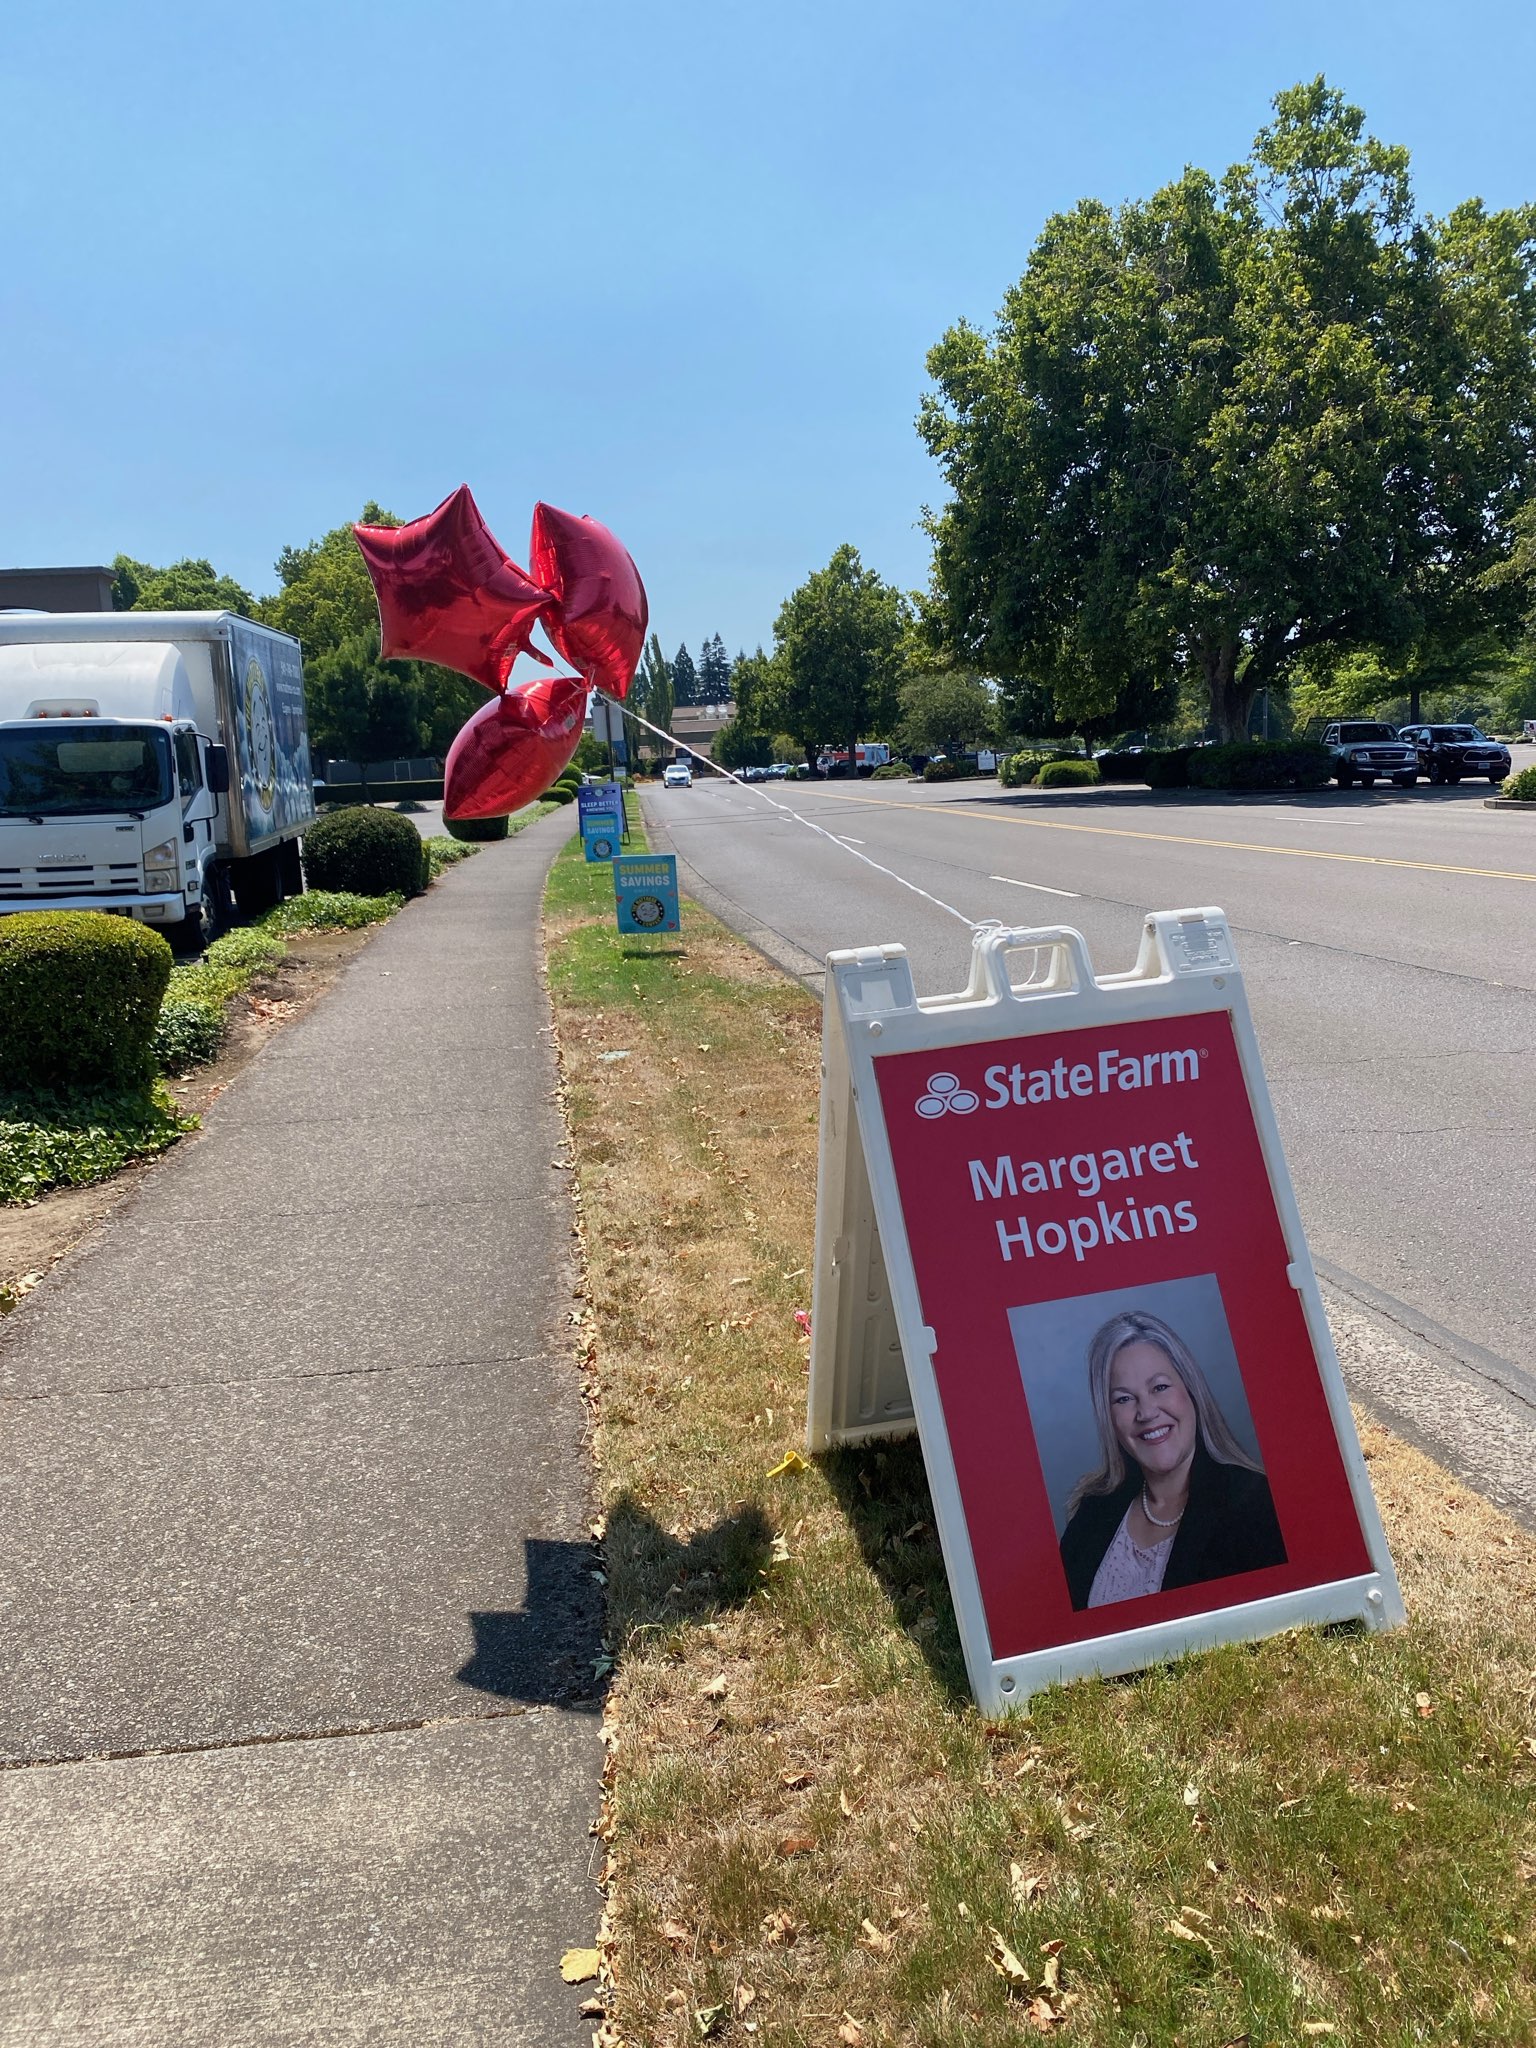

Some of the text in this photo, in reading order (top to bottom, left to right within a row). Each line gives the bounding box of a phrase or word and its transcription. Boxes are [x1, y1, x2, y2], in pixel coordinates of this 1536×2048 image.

[619, 864, 669, 875] SUMMER
[620, 876, 671, 887] SAVINGS
[968, 1131, 1199, 1202] Margaret
[995, 1196, 1199, 1262] Hopkins
